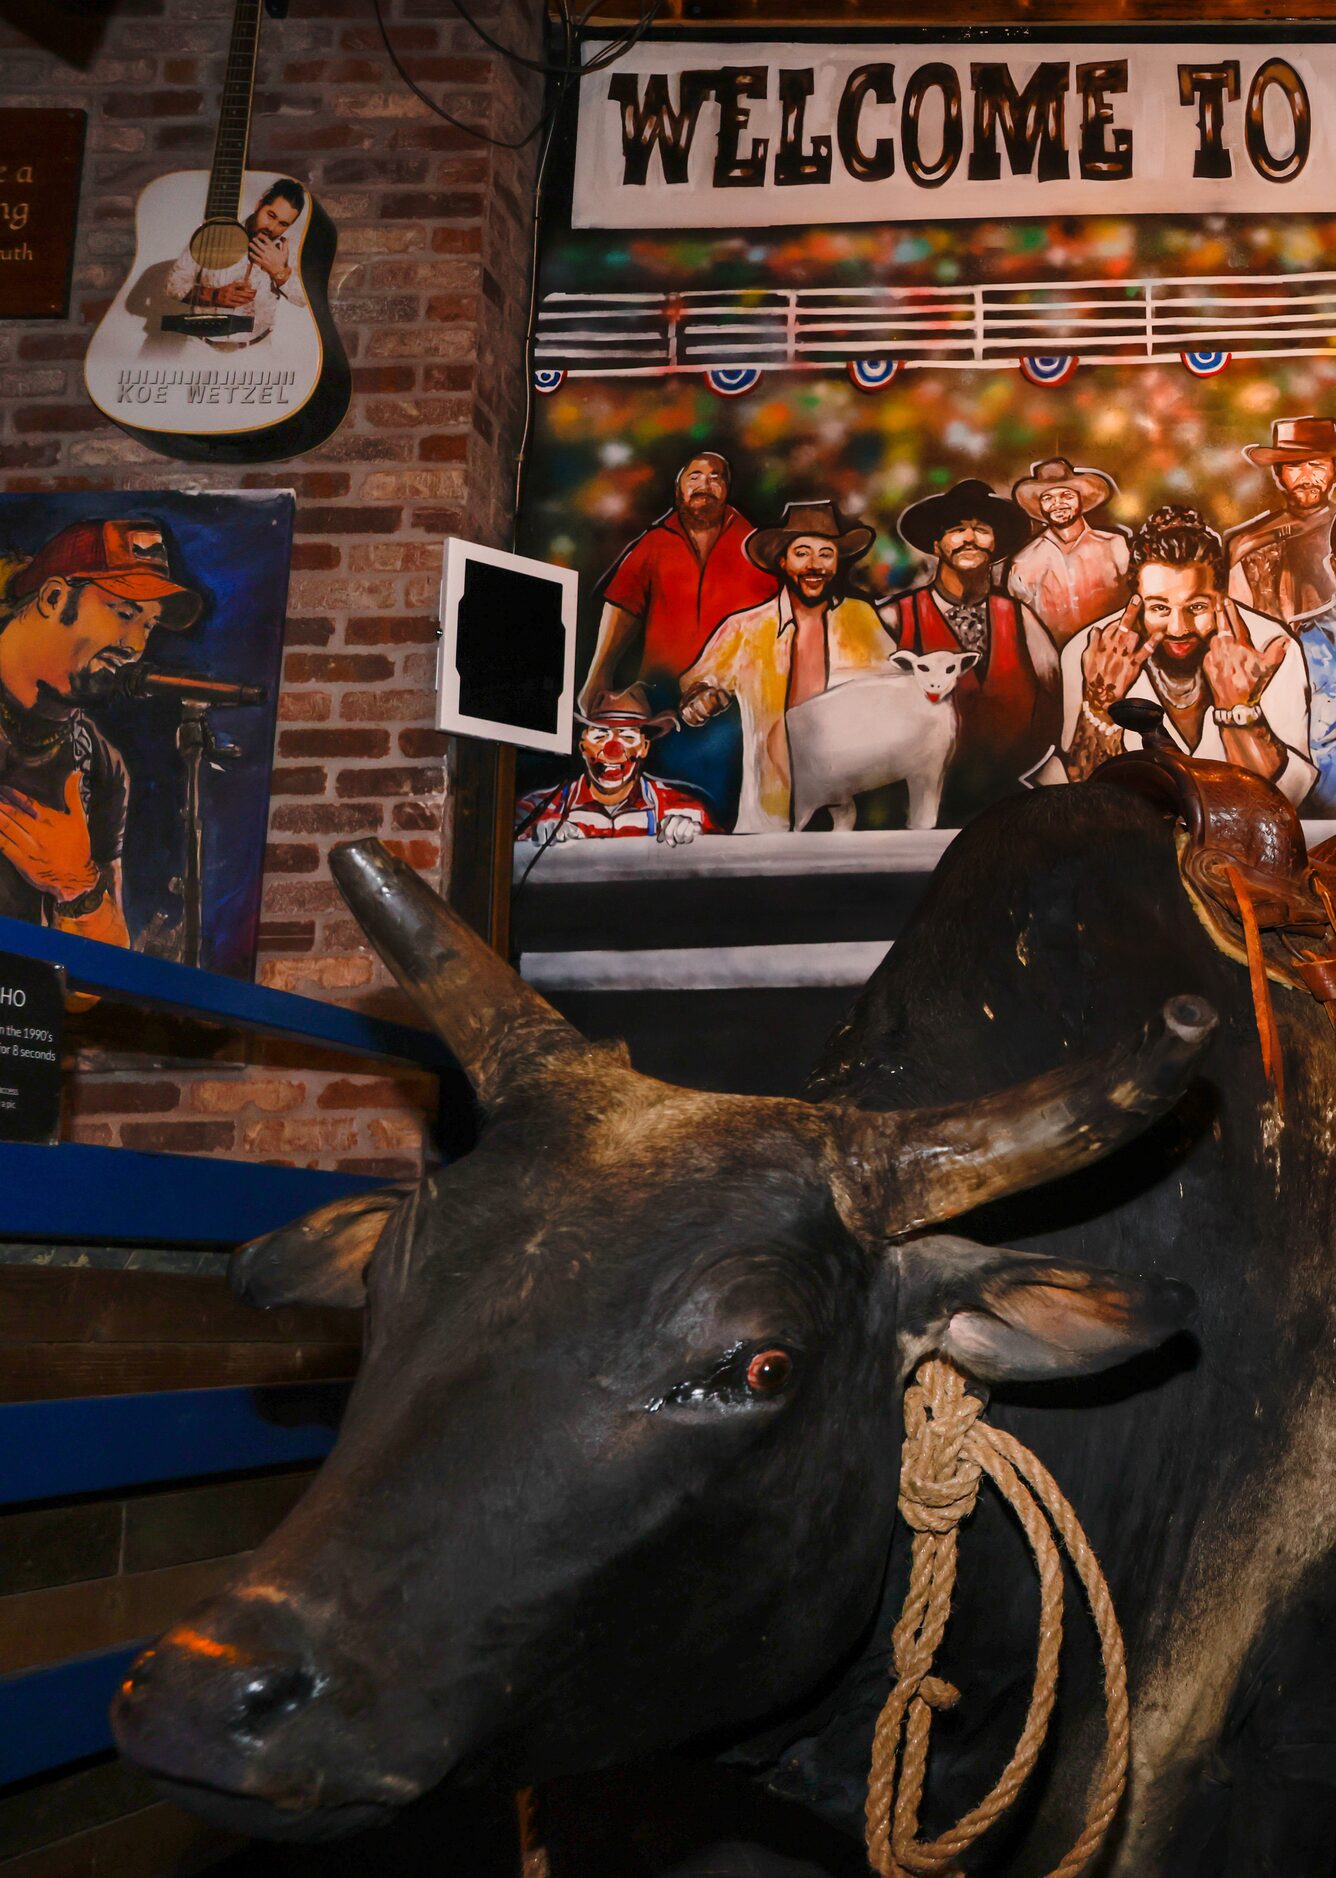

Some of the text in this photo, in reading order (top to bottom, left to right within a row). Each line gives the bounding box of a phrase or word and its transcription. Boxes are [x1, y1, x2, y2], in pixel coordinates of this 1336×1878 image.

[607, 59, 1134, 189] WELCOME
[1178, 57, 1312, 184] TO
[117, 385, 290, 404] KOE WETZEL
[6, 1025, 22, 1038] the
[24, 1028, 54, 1043] 1990's
[12, 1044, 20, 1057] 8
[20, 1048, 57, 1062] seconds
